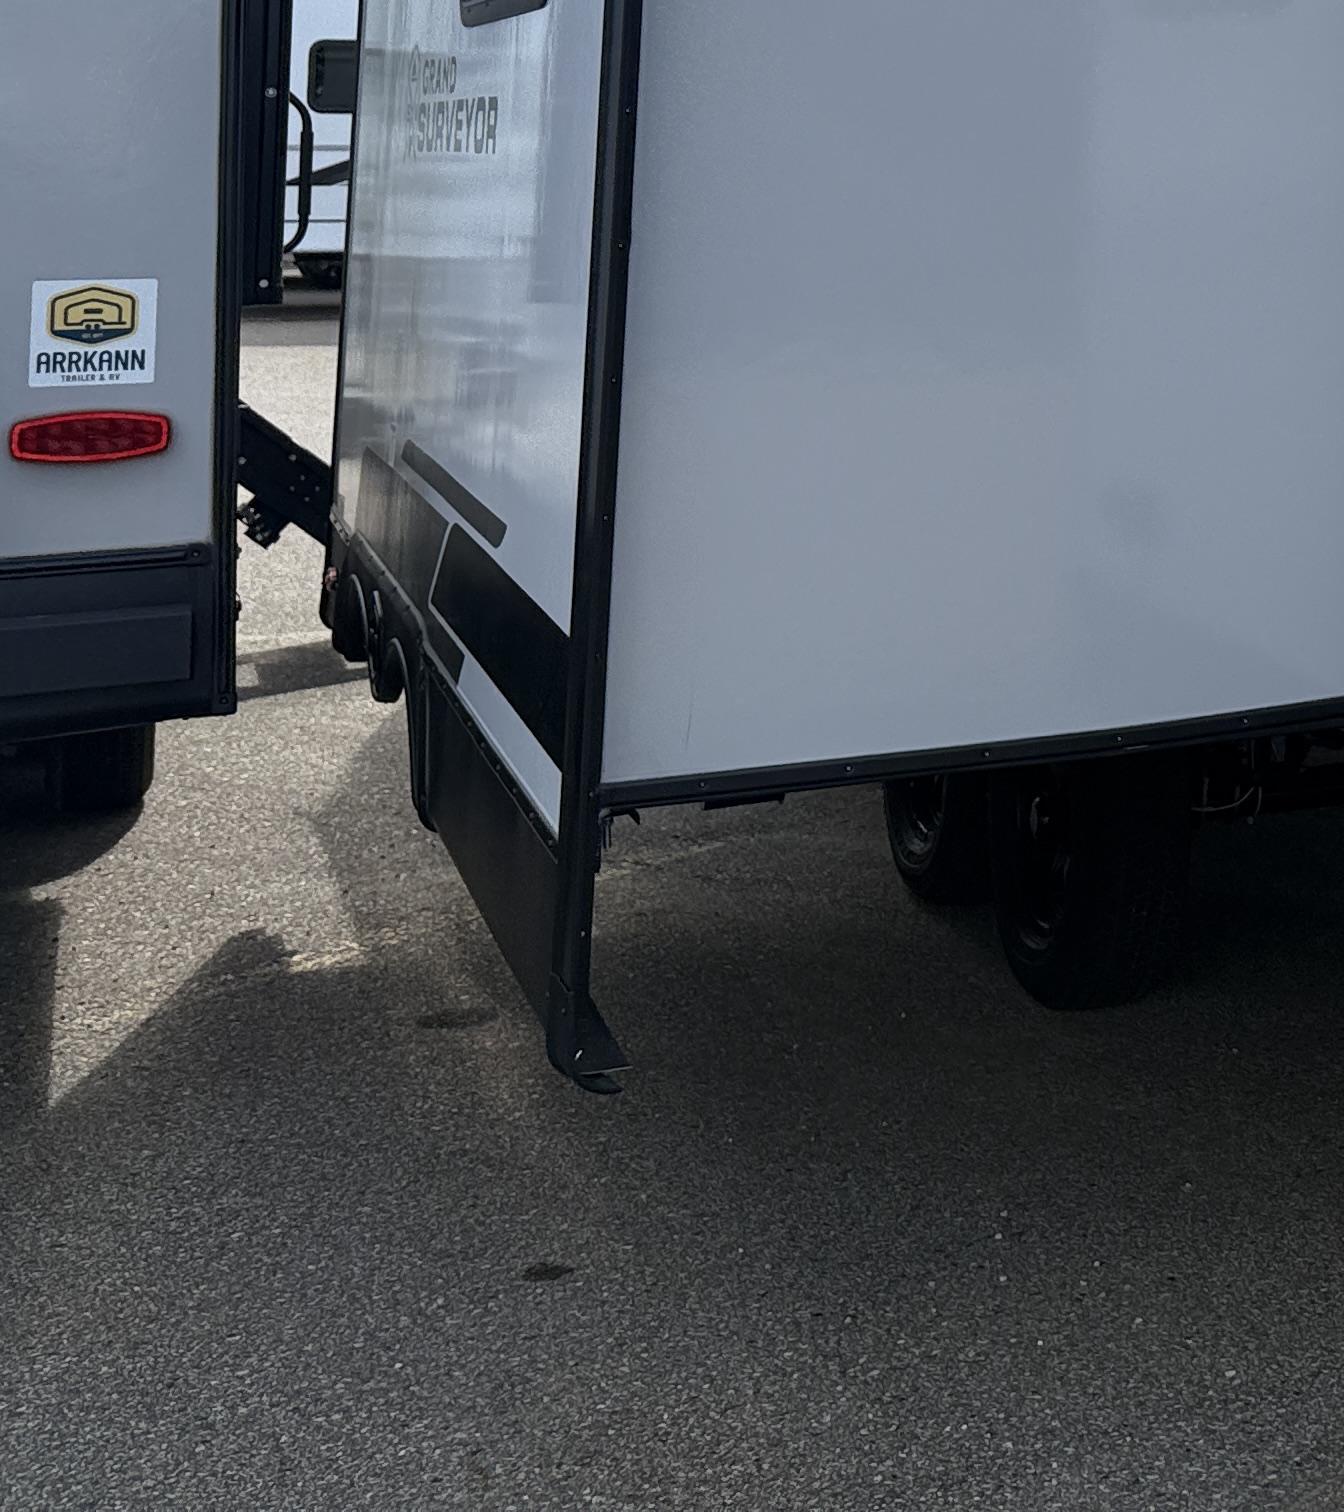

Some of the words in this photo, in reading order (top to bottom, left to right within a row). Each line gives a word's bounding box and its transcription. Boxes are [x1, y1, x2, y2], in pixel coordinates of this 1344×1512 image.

[422, 56, 457, 95] GRAND
[417, 96, 498, 155] SURVEYOR
[36, 349, 146, 374] ARRKANN
[61, 374, 96, 382] TRAILER
